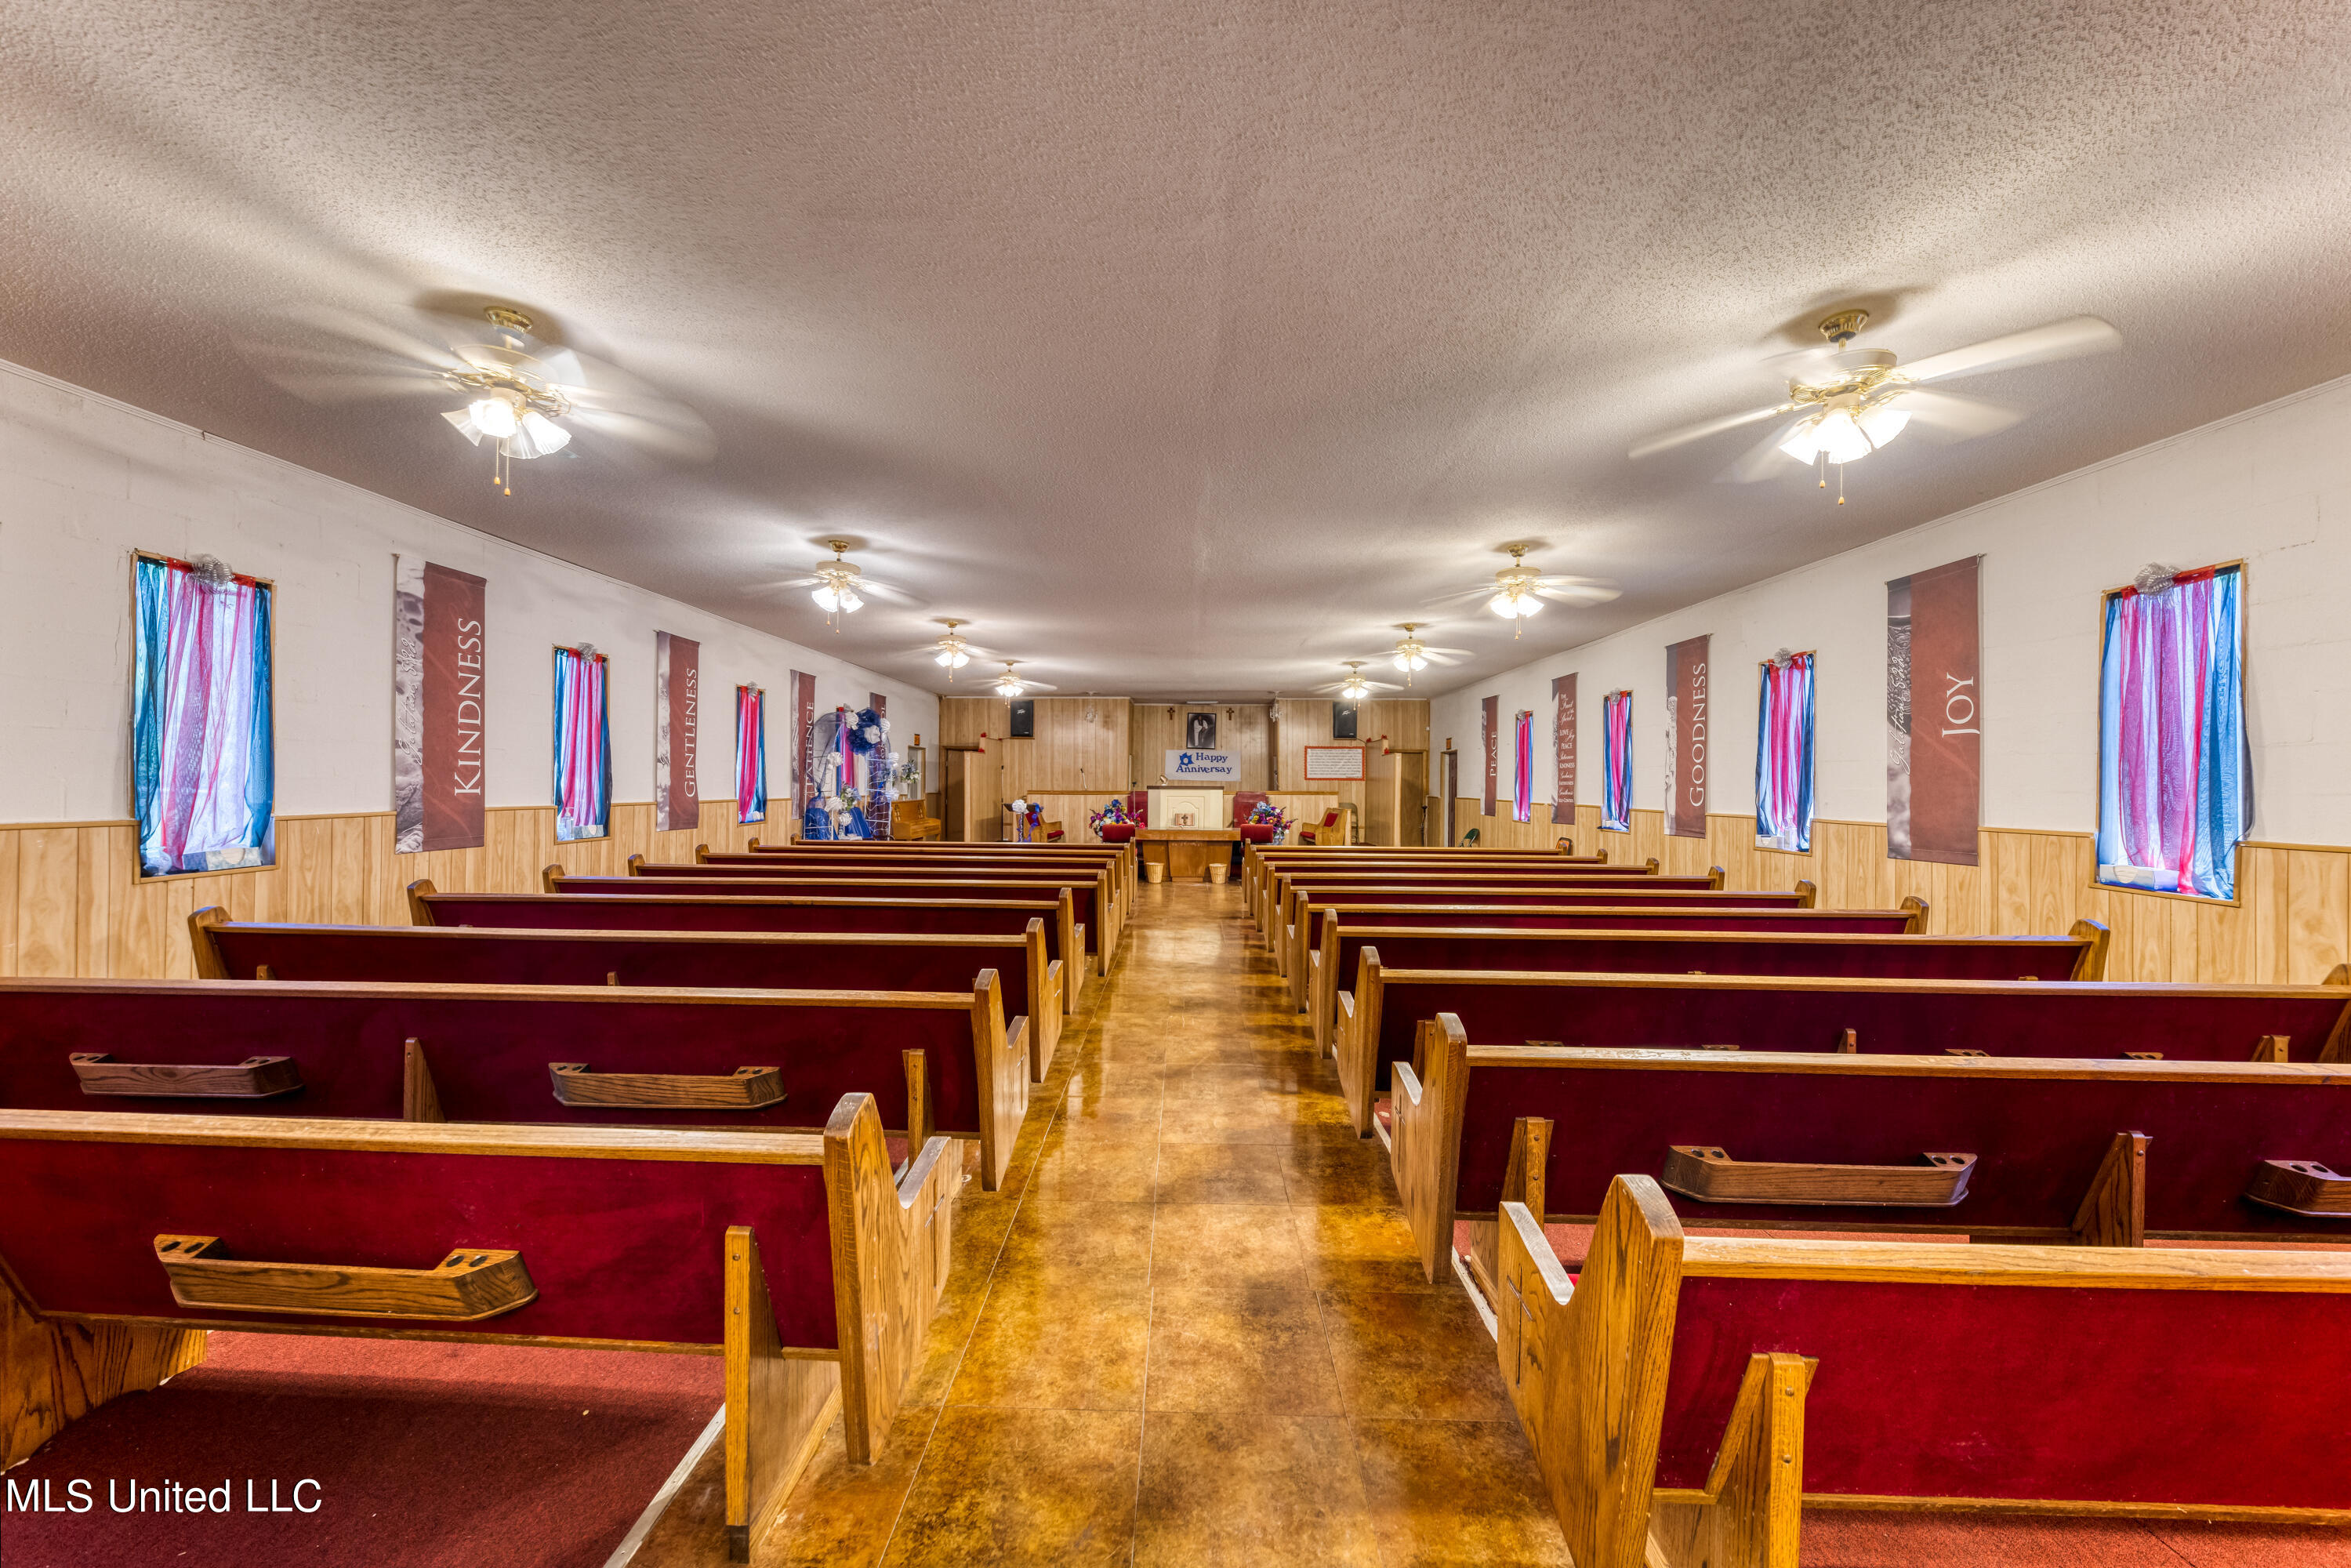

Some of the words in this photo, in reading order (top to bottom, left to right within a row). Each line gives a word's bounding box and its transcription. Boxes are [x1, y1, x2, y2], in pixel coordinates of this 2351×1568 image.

[454, 618, 482, 797] KINDNESS
[1892, 655, 1906, 689] 5:22
[1942, 672, 1980, 739] JOY
[684, 668, 697, 797] GENTLENESS
[1176, 764, 1232, 774] Anniversay
[1195, 752, 1228, 764] Happy
[1689, 662, 1707, 808] GOODNESS
[1888, 696, 1910, 775] Galatians
